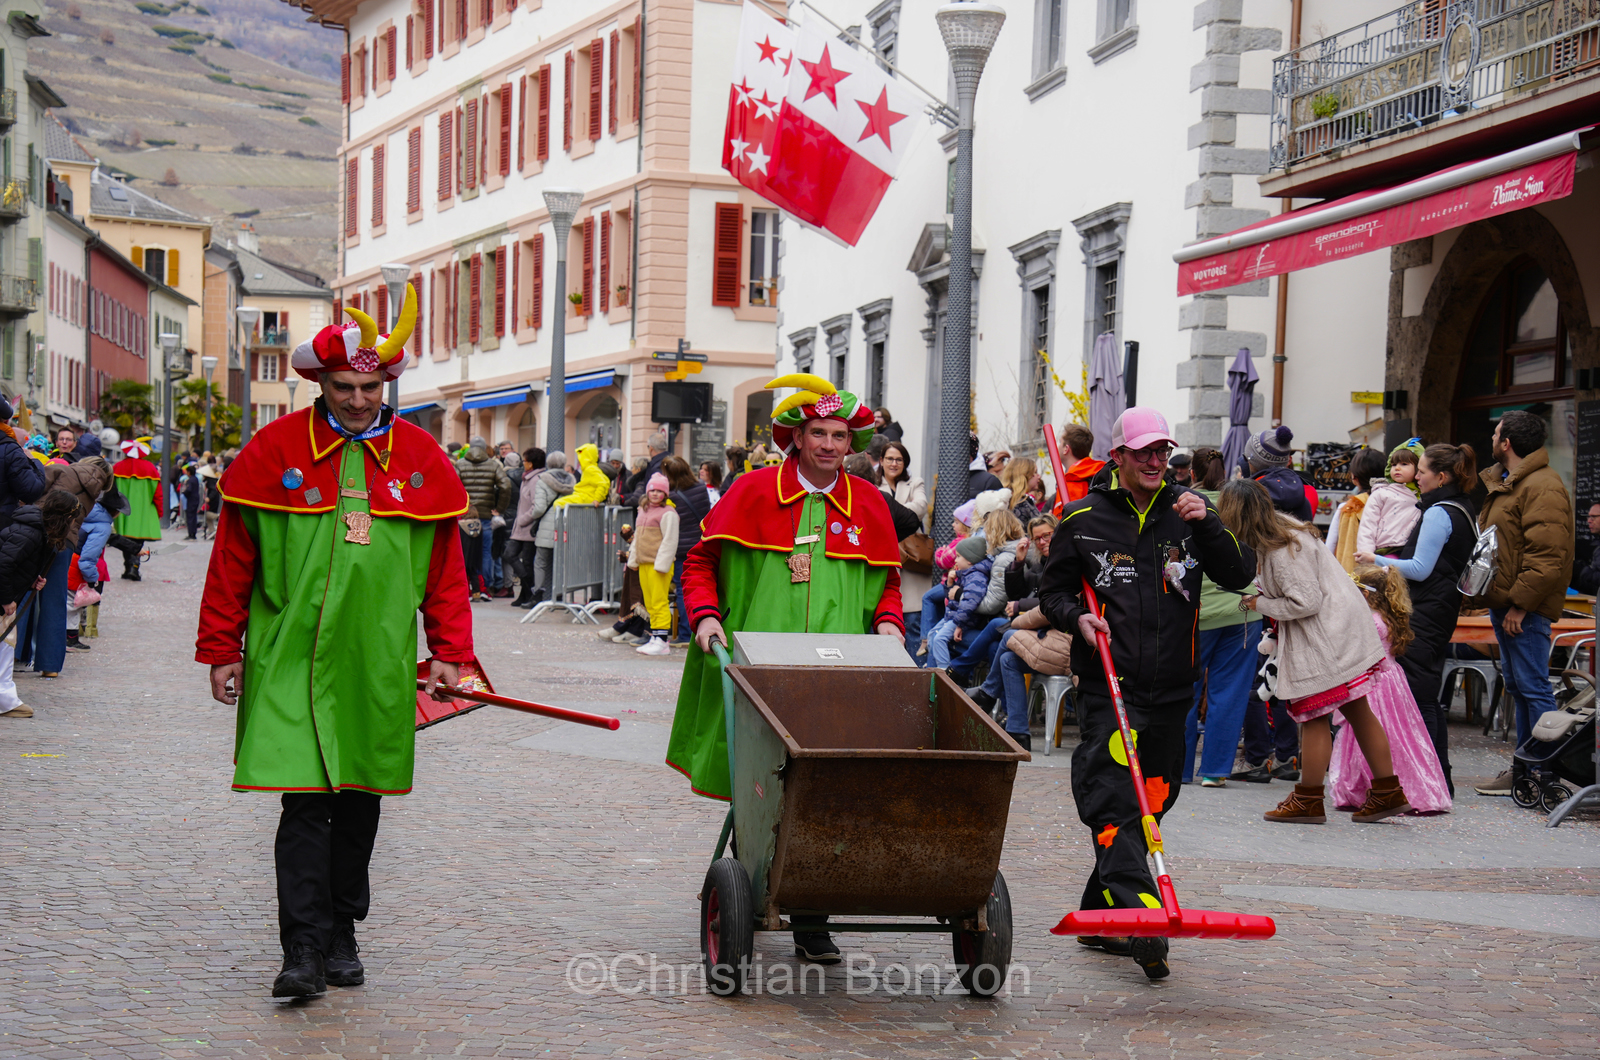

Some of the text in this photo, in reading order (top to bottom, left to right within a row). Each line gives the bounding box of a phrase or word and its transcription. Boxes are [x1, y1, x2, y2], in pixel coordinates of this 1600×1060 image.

[1420, 202, 1469, 222] HURLEVENT
[1334, 242, 1364, 254] brasserie
[1193, 264, 1228, 281] MONTORGE
